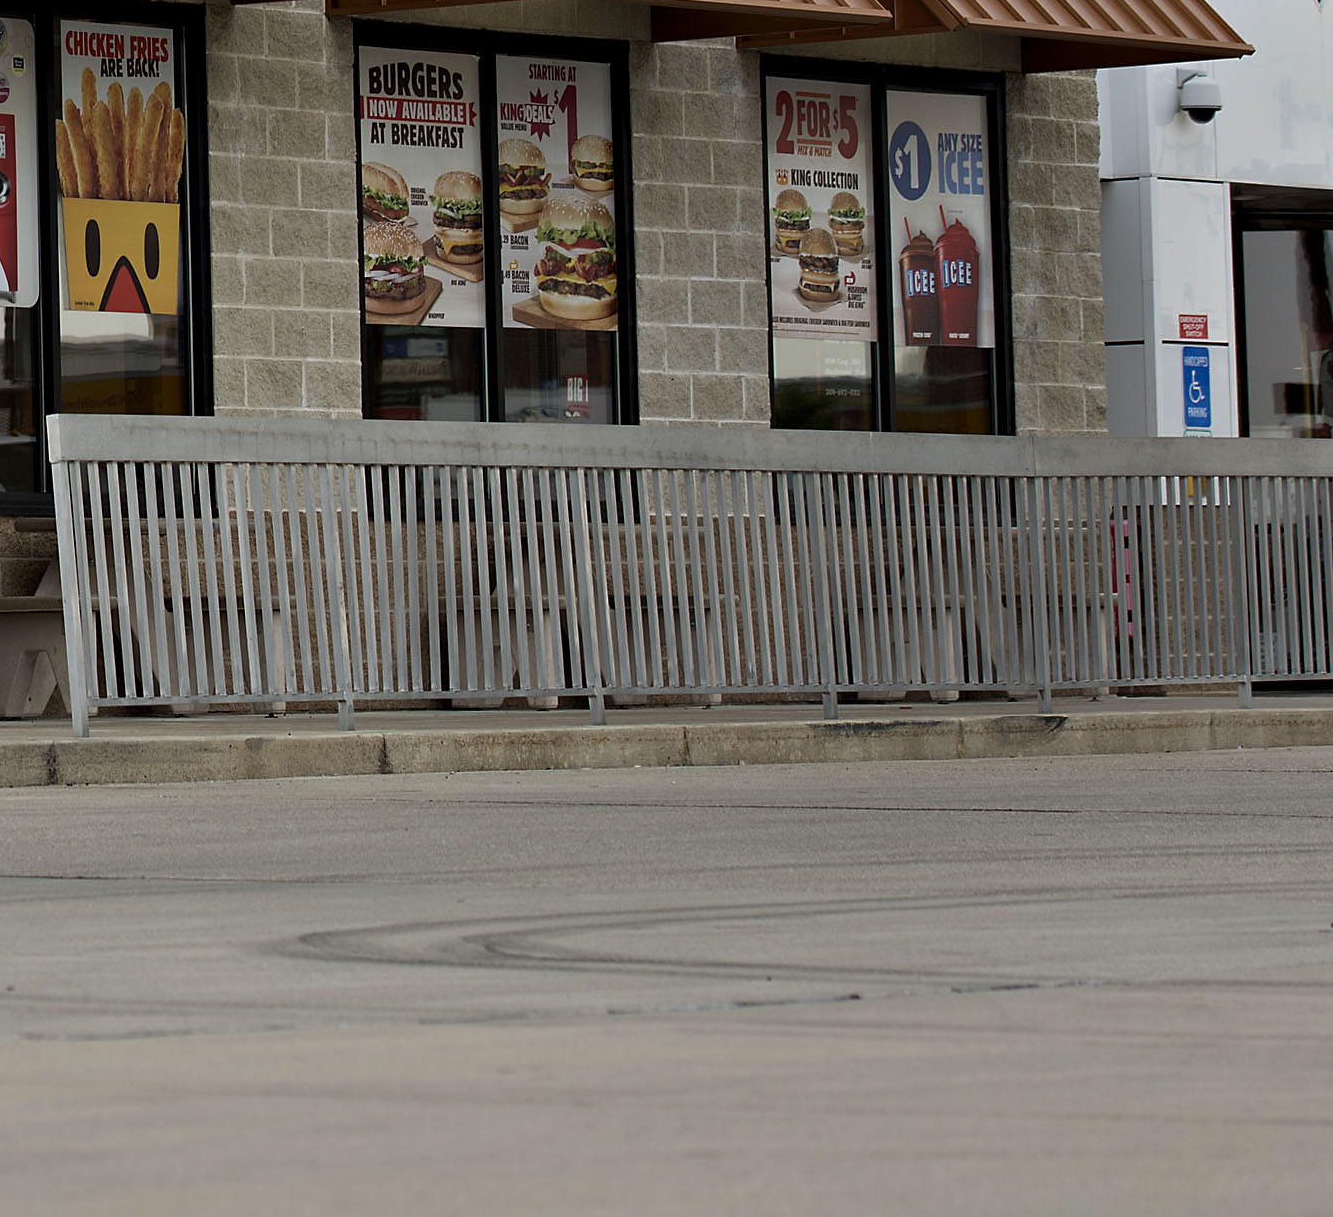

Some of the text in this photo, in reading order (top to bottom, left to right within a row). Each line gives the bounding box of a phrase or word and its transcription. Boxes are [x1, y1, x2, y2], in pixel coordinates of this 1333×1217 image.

[65, 30, 169, 63] CHICKEN FRIES
[101, 58, 160, 78] ARE BACK!
[528, 63, 577, 82] STARTING AT
[368, 62, 464, 100] BURGERS
[369, 99, 465, 122] NOW AVAILABLE
[500, 102, 555, 125] KING DEALS
[371, 122, 464, 149] AT BREAKFAST
[554, 84, 578, 174] $1
[775, 90, 859, 160] 2 FOR $5
[797, 145, 808, 155] MIX
[814, 147, 832, 158] MATCH
[938, 133, 982, 153] ANY SIZE
[895, 134, 920, 189] $1
[937, 151, 984, 195] ICEE
[791, 169, 859, 190] KING COLLECTION
[510, 235, 529, 245] BACON
[512, 270, 530, 279] BACON
[906, 269, 935, 296] ICEE
[942, 260, 972, 288] ICEE
[512, 285, 530, 294] DELUXE
[567, 378, 583, 402] BIG
